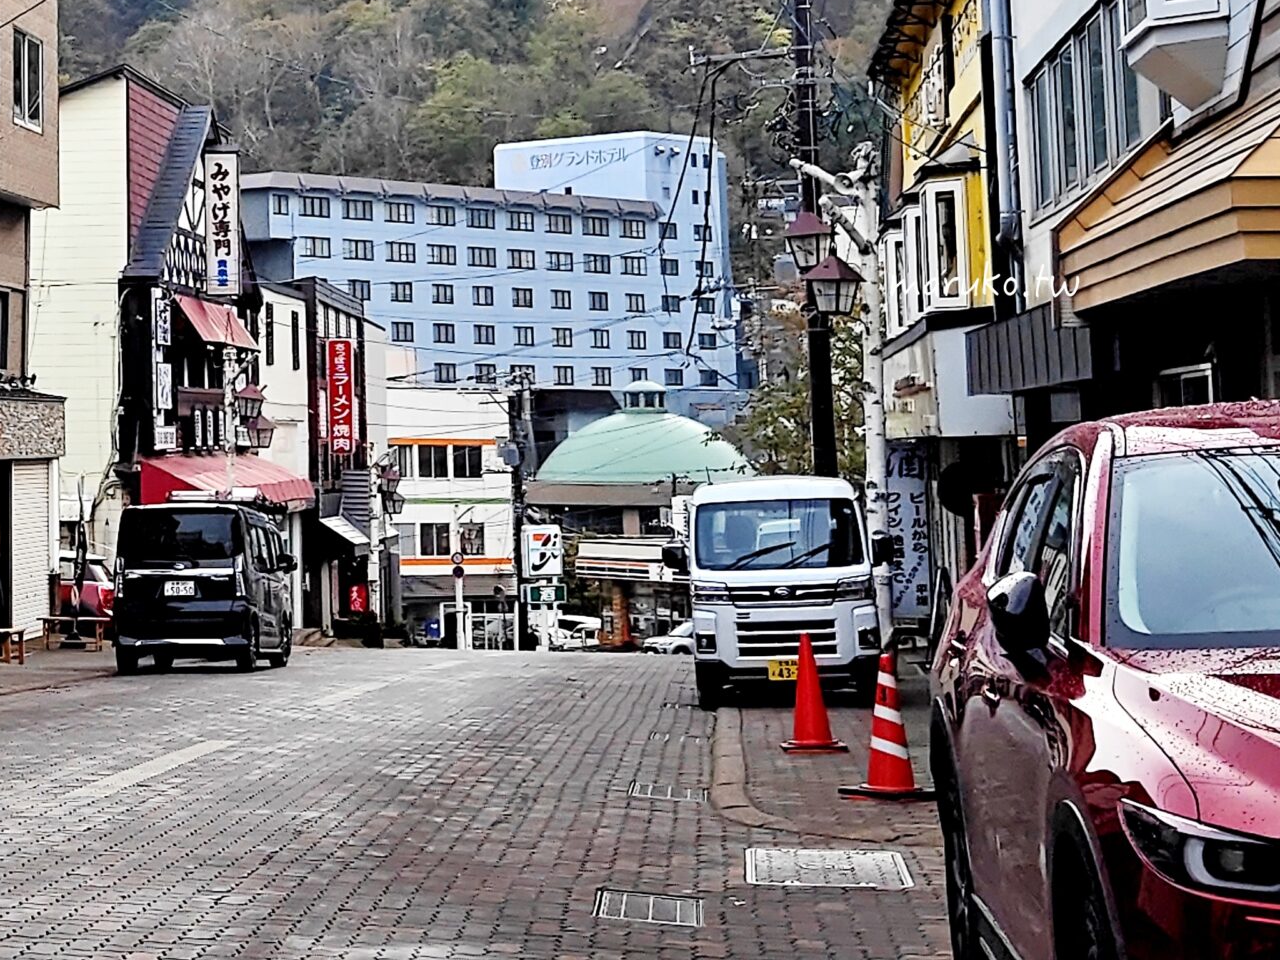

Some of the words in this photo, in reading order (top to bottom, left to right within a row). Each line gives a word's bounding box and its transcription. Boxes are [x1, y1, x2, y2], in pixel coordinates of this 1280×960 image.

[530, 148, 627, 170] 登別グランドホテル
[210, 162, 231, 257] みやげ専門
[539, 587, 556, 602] 酒
